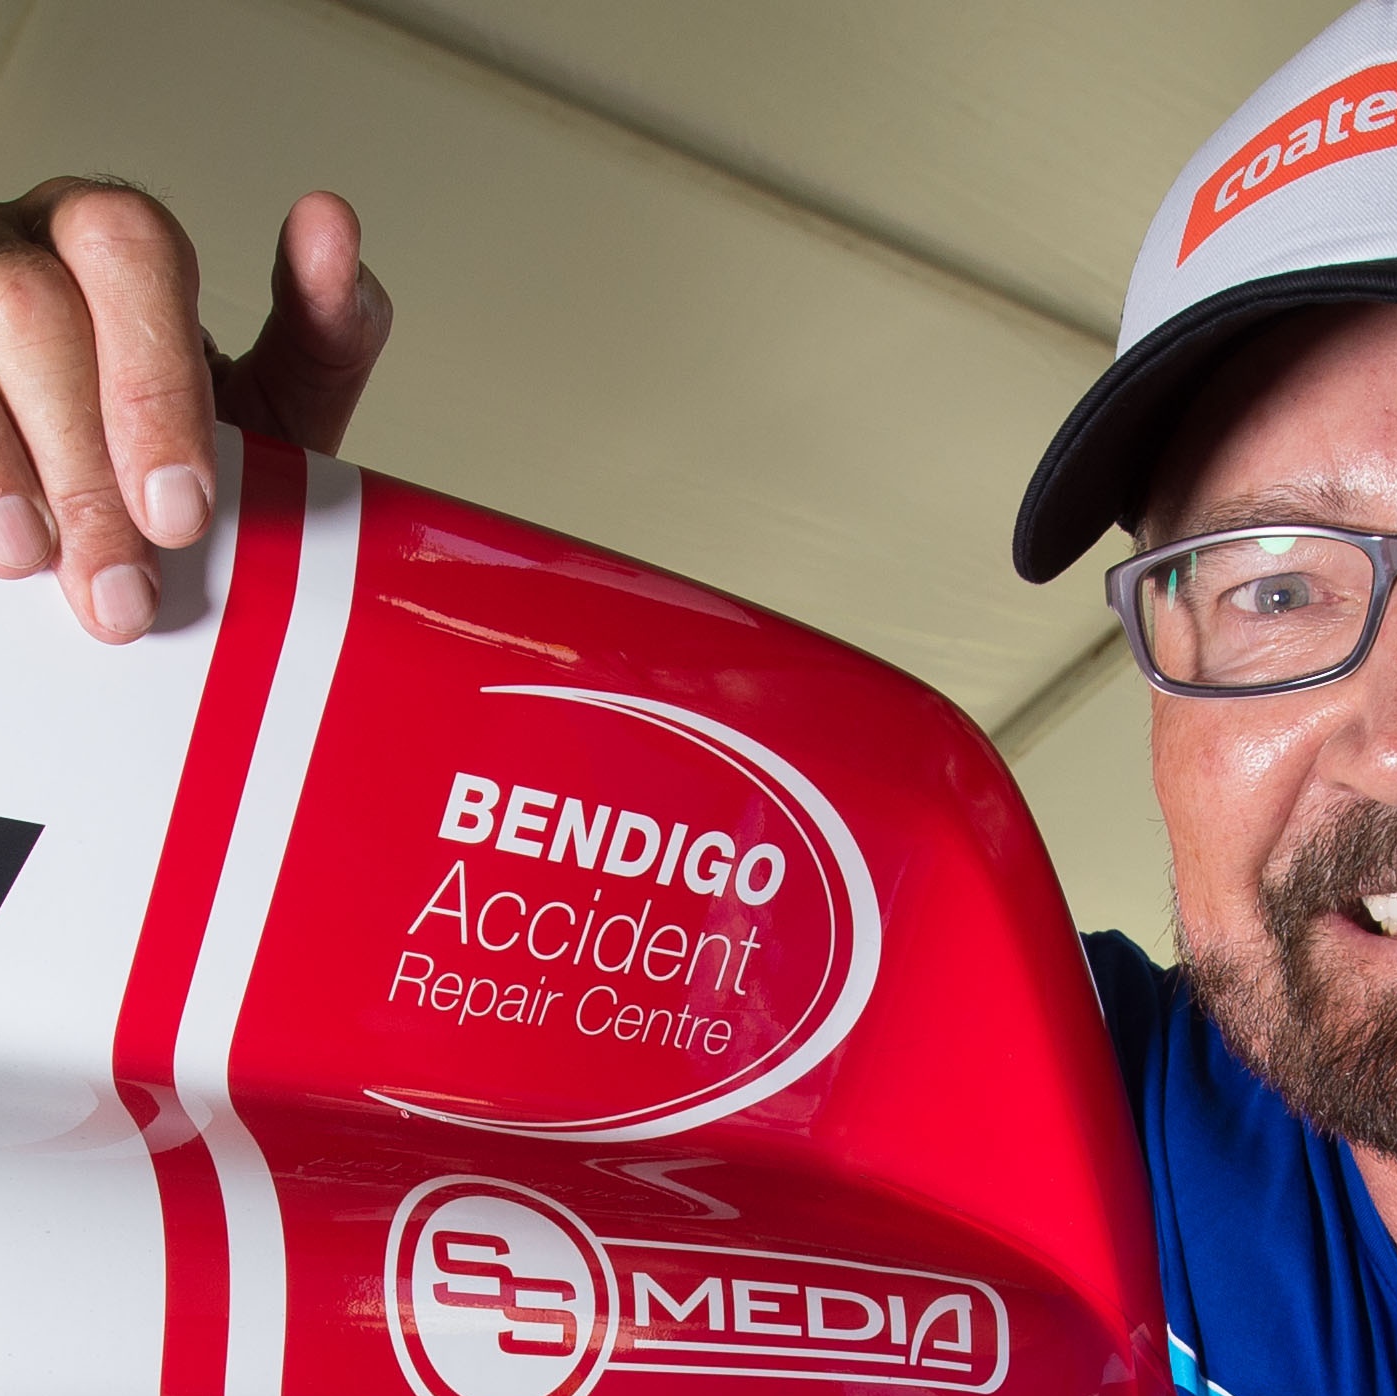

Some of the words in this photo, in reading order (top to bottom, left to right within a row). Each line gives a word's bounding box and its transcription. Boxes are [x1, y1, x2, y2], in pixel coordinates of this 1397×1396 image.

[438, 771, 786, 906] BENDIGO
[407, 859, 761, 996] Accident
[388, 951, 564, 1026] Repair
[575, 985, 732, 1055] Centre
[632, 1271, 973, 1366] MEDIA
